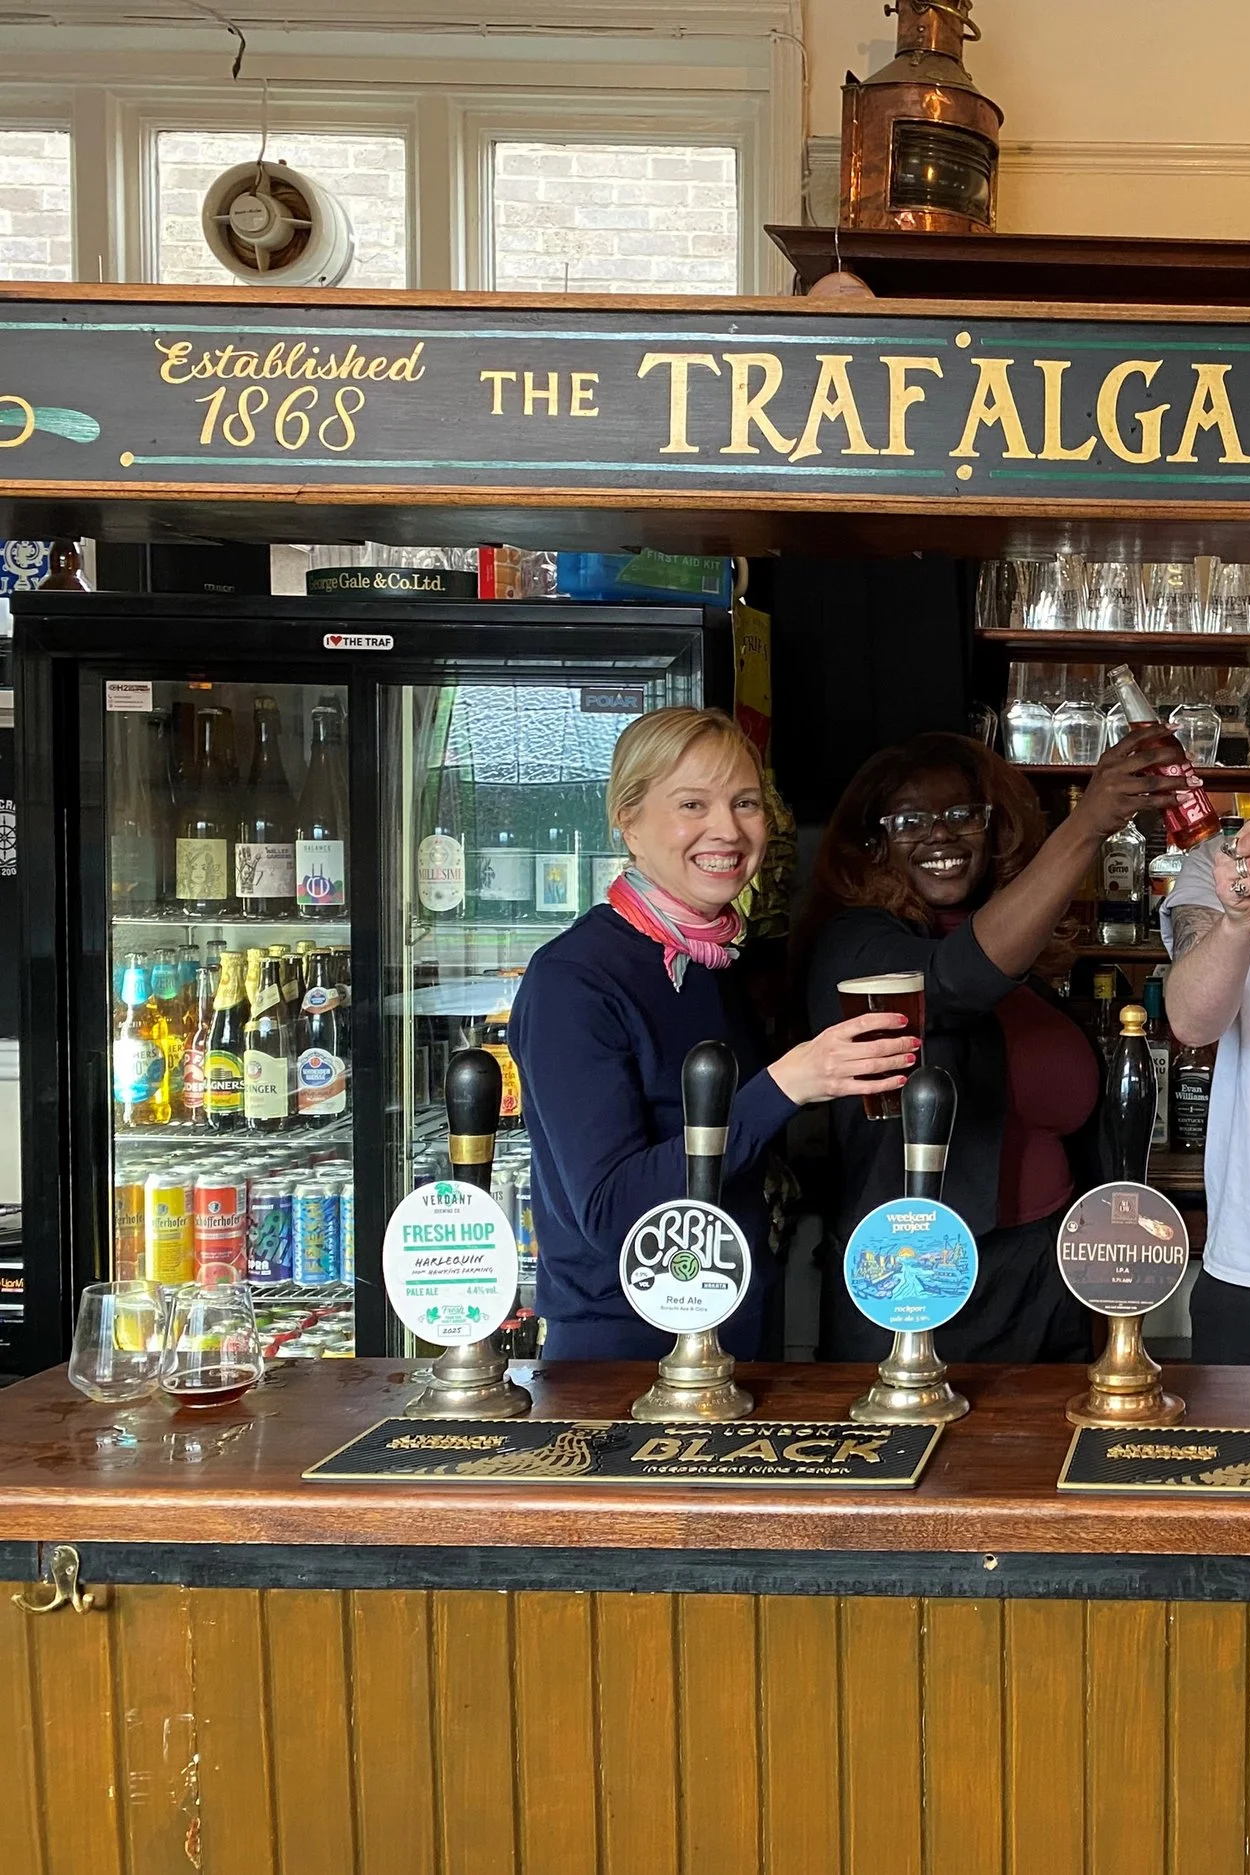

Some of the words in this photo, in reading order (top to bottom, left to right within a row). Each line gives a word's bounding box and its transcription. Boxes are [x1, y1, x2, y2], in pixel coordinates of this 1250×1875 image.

[155, 337, 425, 384] Established
[480, 371, 600, 417] THE
[196, 385, 365, 451] 1868
[647, 550, 678, 563] FIRST
[682, 555, 700, 567] AID
[703, 560, 720, 570] KIT
[339, 572, 370, 589] Gale
[343, 637, 363, 646] THE
[365, 638, 391, 647] TRAF
[1181, 1084, 1202, 1093] Evan
[1175, 1092, 1209, 1101] Williams
[423, 1194, 472, 1206] VERDANT
[886, 1210, 937, 1222] weekend
[403, 1224, 455, 1243] FRESH
[460, 1223, 495, 1241] HOP
[891, 1222, 930, 1234] project
[1063, 1242, 1137, 1263] ELEVENTH
[1141, 1245, 1184, 1264] HOUR
[415, 1255, 485, 1268] HARLEQUIN
[406, 1288, 424, 1296] PALE
[425, 1288, 439, 1296] ALE
[666, 1296, 684, 1304] Red
[688, 1296, 702, 1304] Ale
[441, 1305, 465, 1315] Fresh
[894, 1305, 926, 1313] rockport
[442, 1327, 463, 1335] 2025
[723, 1427, 835, 1437] LONDON
[630, 1438, 890, 1462] BLACK
